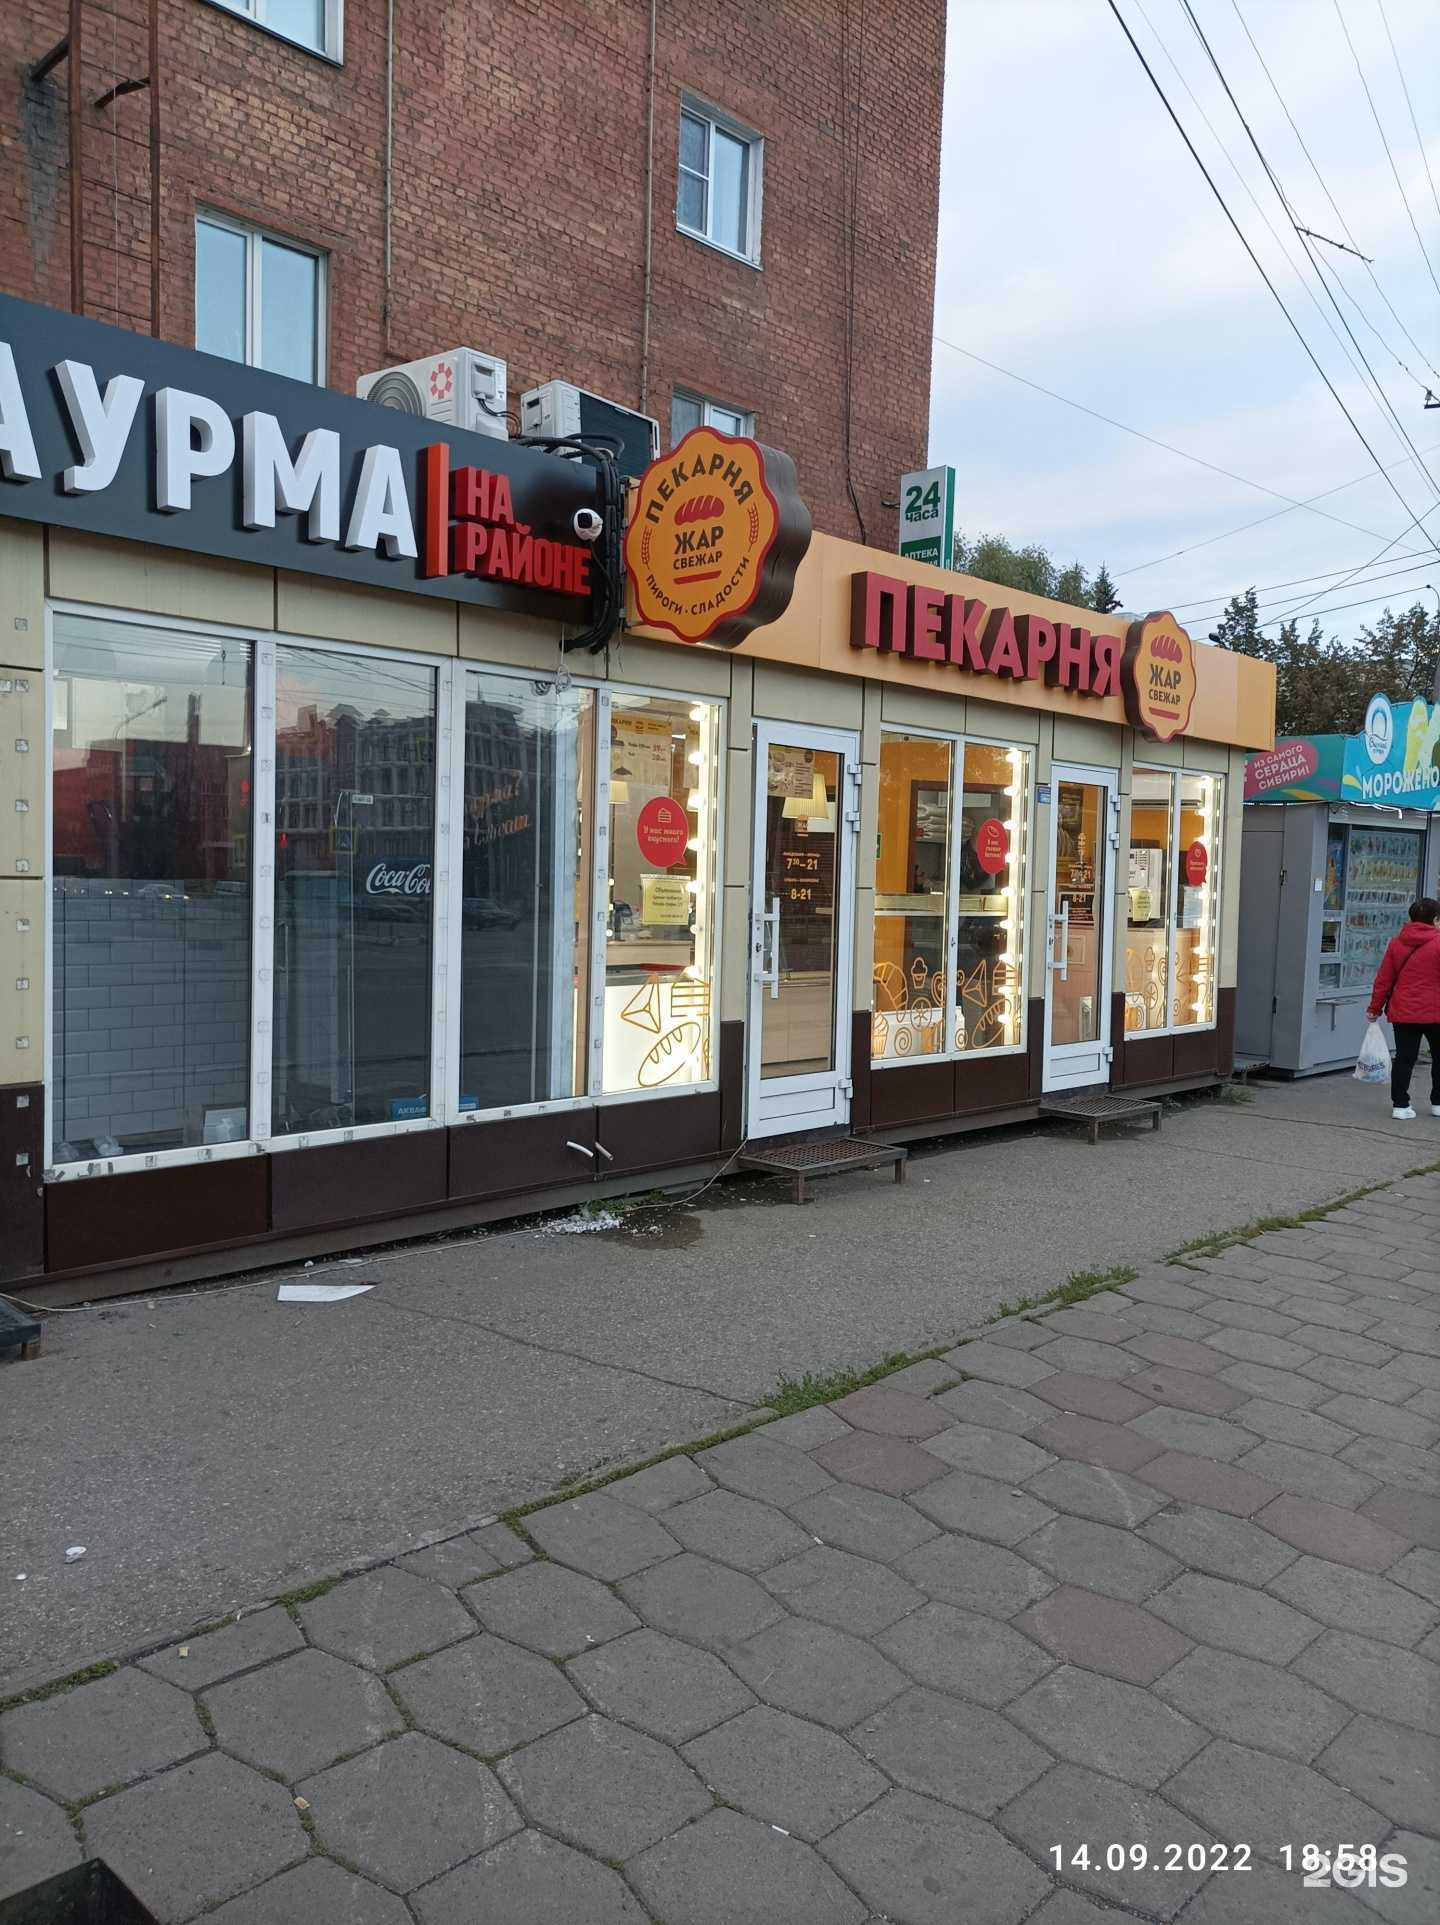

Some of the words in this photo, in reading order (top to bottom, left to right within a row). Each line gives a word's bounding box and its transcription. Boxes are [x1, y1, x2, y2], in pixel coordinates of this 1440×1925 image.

[461, 466, 514, 524] НА
[645, 453, 754, 524] ПЕКАРНЯ
[905, 480, 940, 513] 24
[673, 525, 724, 554] ЖАР
[461, 521, 592, 594] РАЙОНЕ
[673, 550, 723, 570] СВЕЖАР
[645, 574, 683, 616] ПИРОГИ
[691, 556, 750, 616] СЛАДОСТИ
[854, 571, 1121, 697] ПЕКАРНЯ
[1149, 664, 1182, 689] ЖАР
[1148, 689, 1181, 705] СВЕЖАР
[1254, 760, 1266, 769] ИЗ
[1267, 744, 1303, 764] САМОГО
[1255, 754, 1307, 779] СЕРДЦА
[1258, 765, 1310, 790] СИБИРИ!
[1362, 766, 1440, 800] МОРОЖЕНО
[790, 888, 812, 900] 8-21
